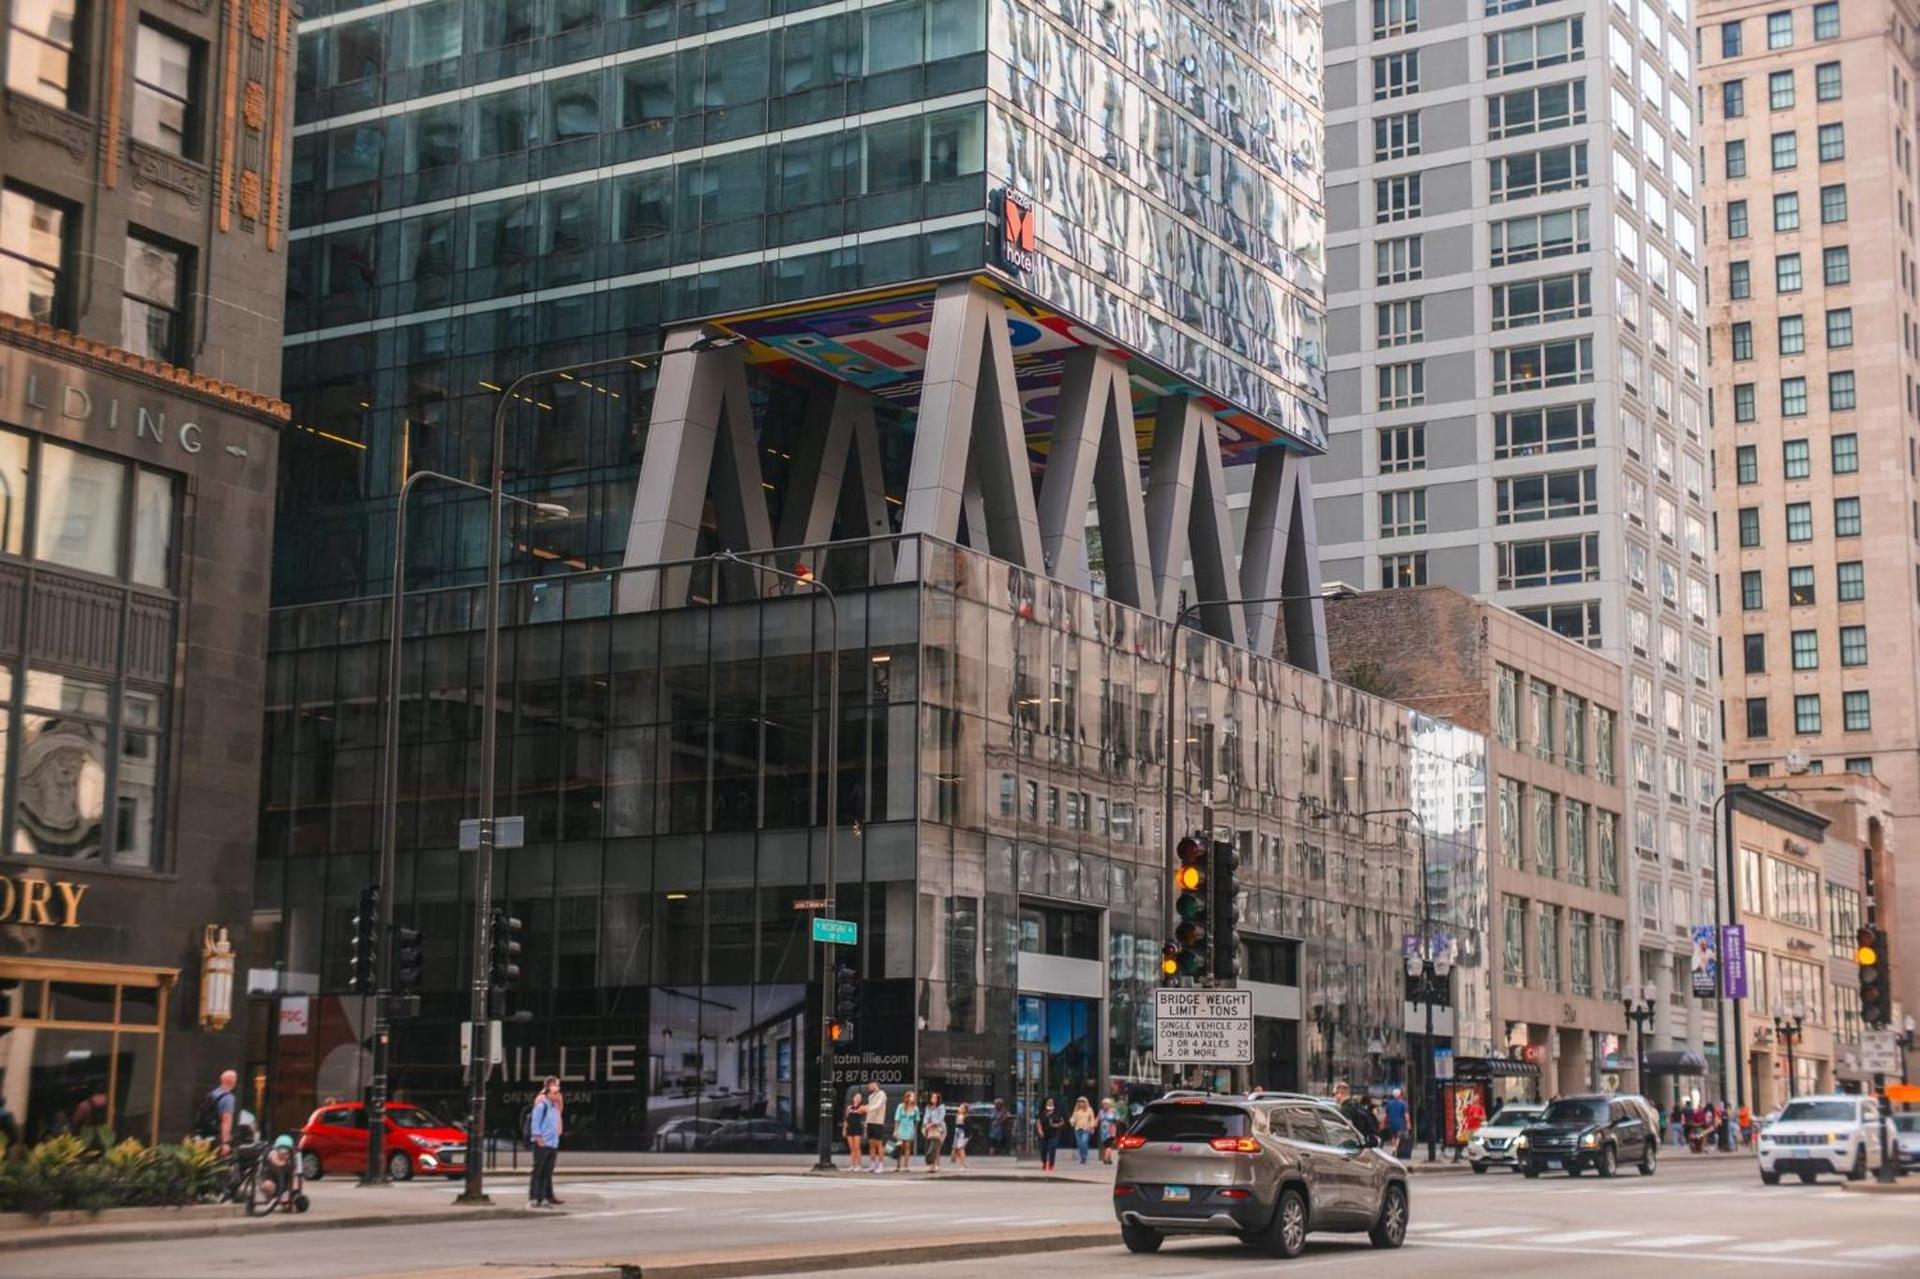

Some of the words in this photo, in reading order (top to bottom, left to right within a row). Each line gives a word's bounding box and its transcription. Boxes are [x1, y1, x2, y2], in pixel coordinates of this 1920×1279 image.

[1006, 240, 1035, 273] hotel
[1160, 994, 1200, 1004] BRIDGE
[1206, 995, 1248, 1005] WEIGHT
[1169, 1006, 1197, 1016] LIMIT
[1209, 1006, 1238, 1016] TONS
[1160, 1022, 1190, 1030] SINGLE
[1196, 1022, 1232, 1030] VEHICLE
[1237, 1022, 1248, 1031] 22
[1160, 1030, 1224, 1039] COMBINATIONS
[1201, 1040, 1230, 1048] AXLES
[1237, 1040, 1248, 1048] 29
[1178, 1049, 1190, 1057] OR
[1194, 1049, 1217, 1057] MORE
[815, 1052, 909, 1065] rtatmillie.com
[871, 1070, 902, 1083] 0300
